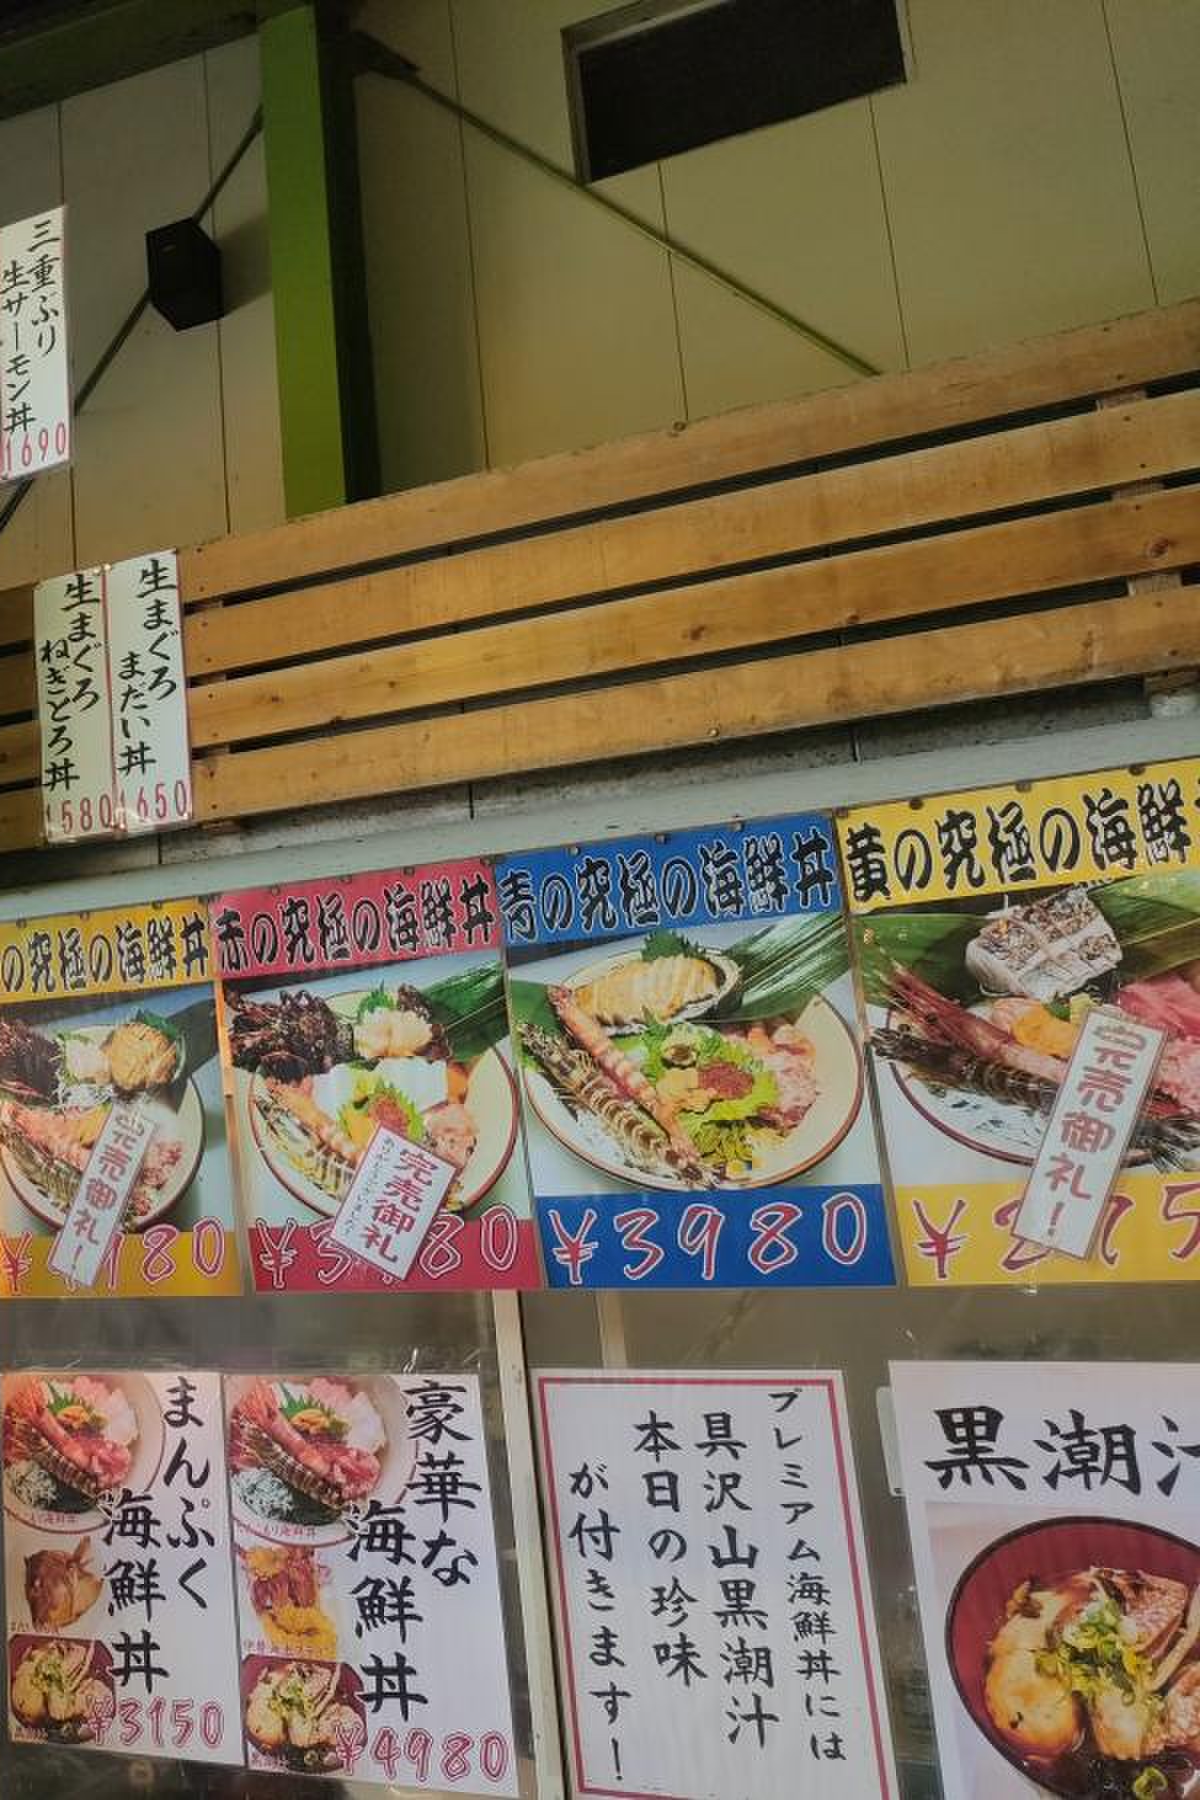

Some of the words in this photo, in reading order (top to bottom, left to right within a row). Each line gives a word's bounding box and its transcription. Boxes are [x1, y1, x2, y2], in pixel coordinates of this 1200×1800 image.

[0, 259, 37, 434] 生サーモン丼
[2, 420, 68, 474] 1690
[62, 573, 101, 712] 生まぐろ
[136, 558, 178, 702] 生まぐろ
[117, 650, 158, 776] まだい丼
[499, 826, 834, 944] 青の究極の海鮮丼
[845, 776, 1200, 904] 黄の究極の海鮮
[216, 876, 500, 973] 赤の究極の海鮮丼
[73, 1108, 145, 1272] 完売御礼！
[1044, 1025, 1148, 1238] 完売御礼！
[254, 1204, 520, 1289] ¥380
[360, 1148, 440, 1264] 完売御礼
[549, 1190, 868, 1288] ¥3980
[162, 1375, 216, 1610] まんぷく
[401, 1379, 483, 1587] 豪華な
[632, 1409, 708, 1689] 本日の珍味
[101, 1487, 171, 1695] 海鮮丼
[346, 1501, 429, 1722] 海鮮丼
[567, 1462, 632, 1782] が付きます！
[694, 1410, 781, 1749] 具沢山黒潮汁
[768, 1386, 848, 1762] プレミアム海鮮丼には
[87, 1696, 225, 1749] ¥3150
[334, 1725, 511, 1783] ¥4980
